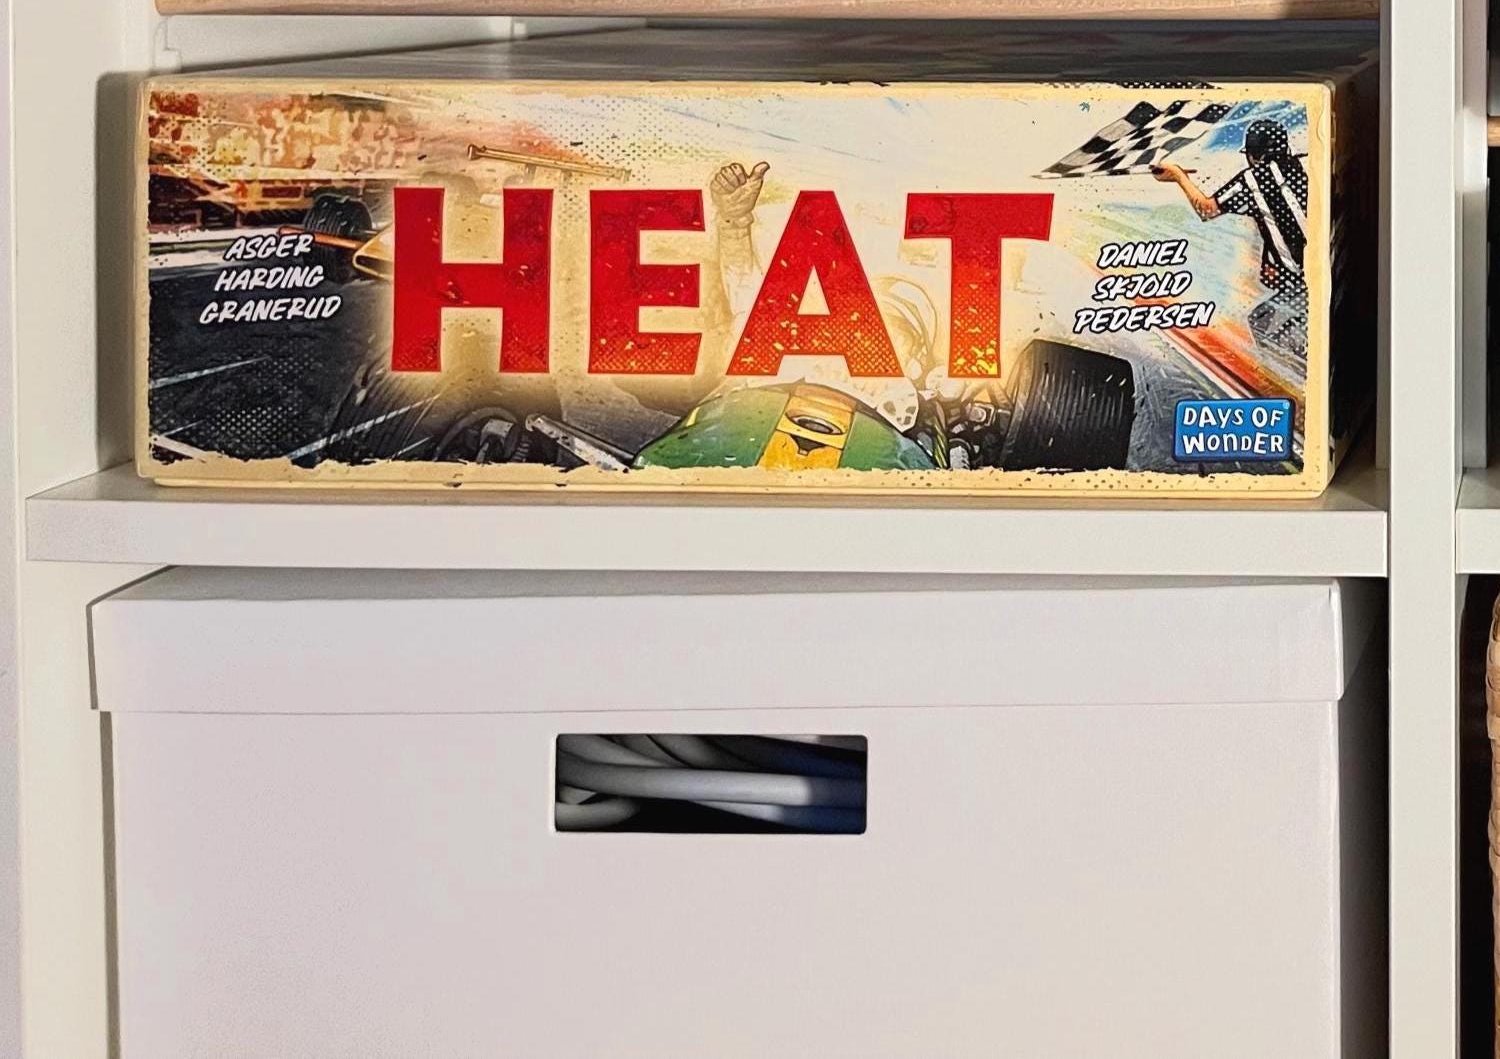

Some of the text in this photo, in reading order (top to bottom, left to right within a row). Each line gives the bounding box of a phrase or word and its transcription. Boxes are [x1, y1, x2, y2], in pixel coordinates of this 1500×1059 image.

[226, 234, 314, 260] ASGER
[1098, 239, 1187, 268] DANIEL
[215, 264, 324, 293] HARDING
[391, 186, 1055, 379] HEAT
[1092, 271, 1193, 302] SKJOLD
[200, 295, 342, 324] GRANERUD
[1074, 303, 1214, 334] PEDERSEN
[1184, 406, 1284, 429] DAYS OF
[1183, 432, 1284, 454] WONDER
